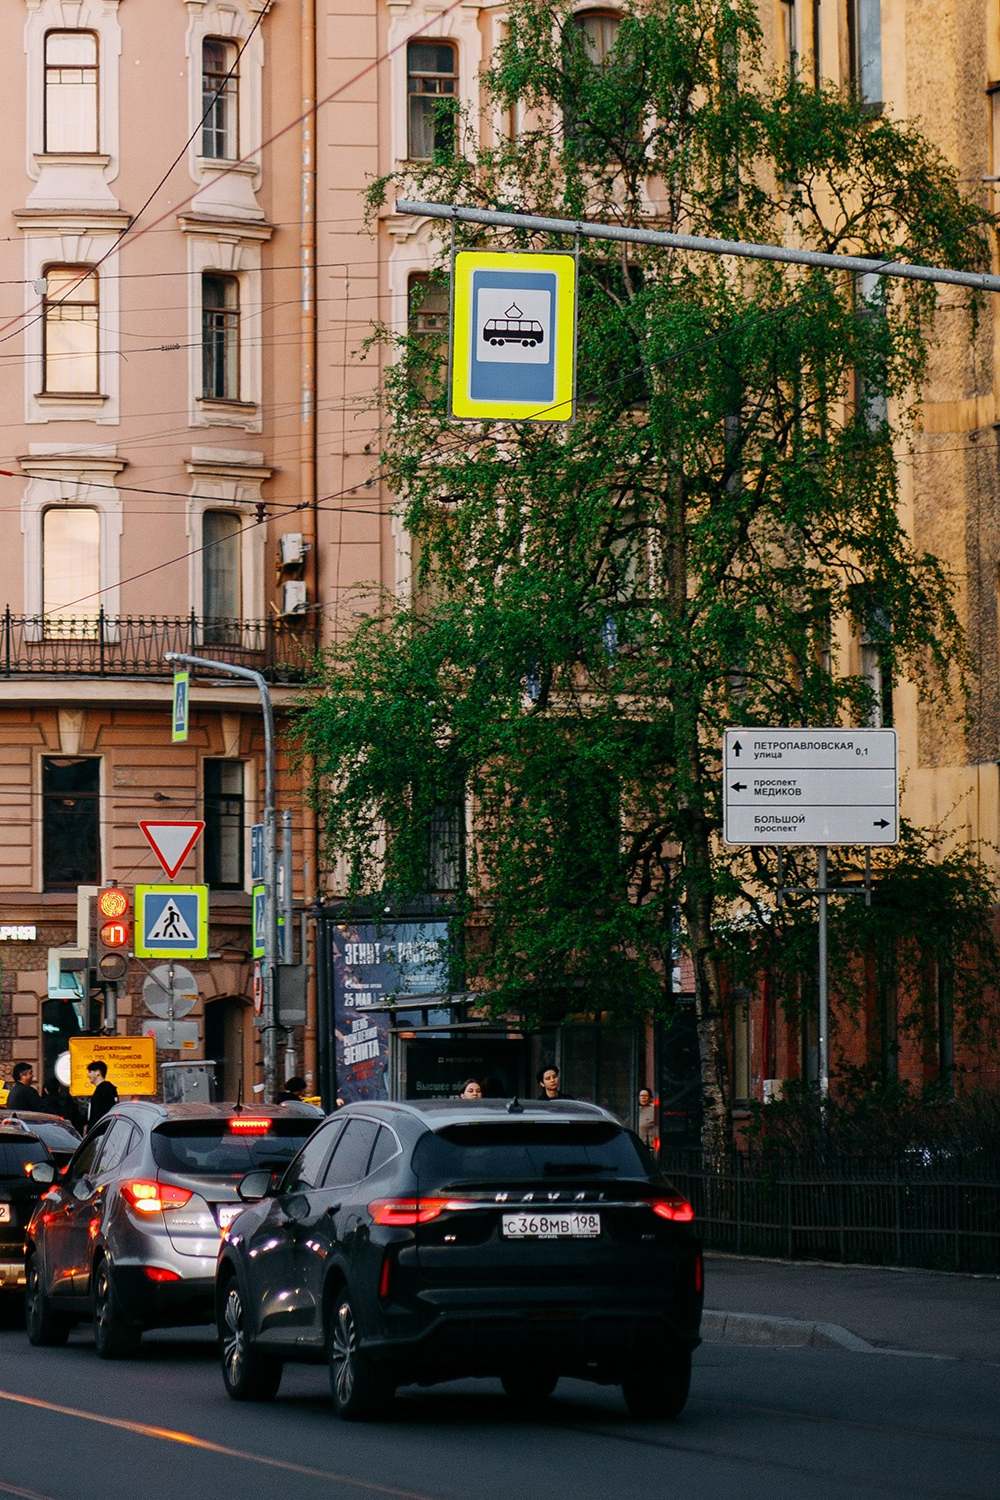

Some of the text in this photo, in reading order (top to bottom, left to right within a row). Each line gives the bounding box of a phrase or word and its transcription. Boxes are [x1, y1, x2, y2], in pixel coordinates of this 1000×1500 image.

[754, 741, 869, 757] ПЕТРОПАВЛОВСКАЯ 0,1
[754, 751, 782, 760] улица
[754, 779, 797, 788] проспект
[754, 788, 802, 797] МЕДИКОВ
[754, 814, 806, 823] БОЛЬШОЙ
[754, 825, 797, 833] проспект
[110, 926, 124, 943] 17
[344, 942, 381, 965] ЗЕНИТ
[344, 992, 354, 1007] 25
[416, 1081, 450, 1091] Высшее
[494, 1192, 607, 1202] HAVAL
[573, 1215, 596, 1228] 198
